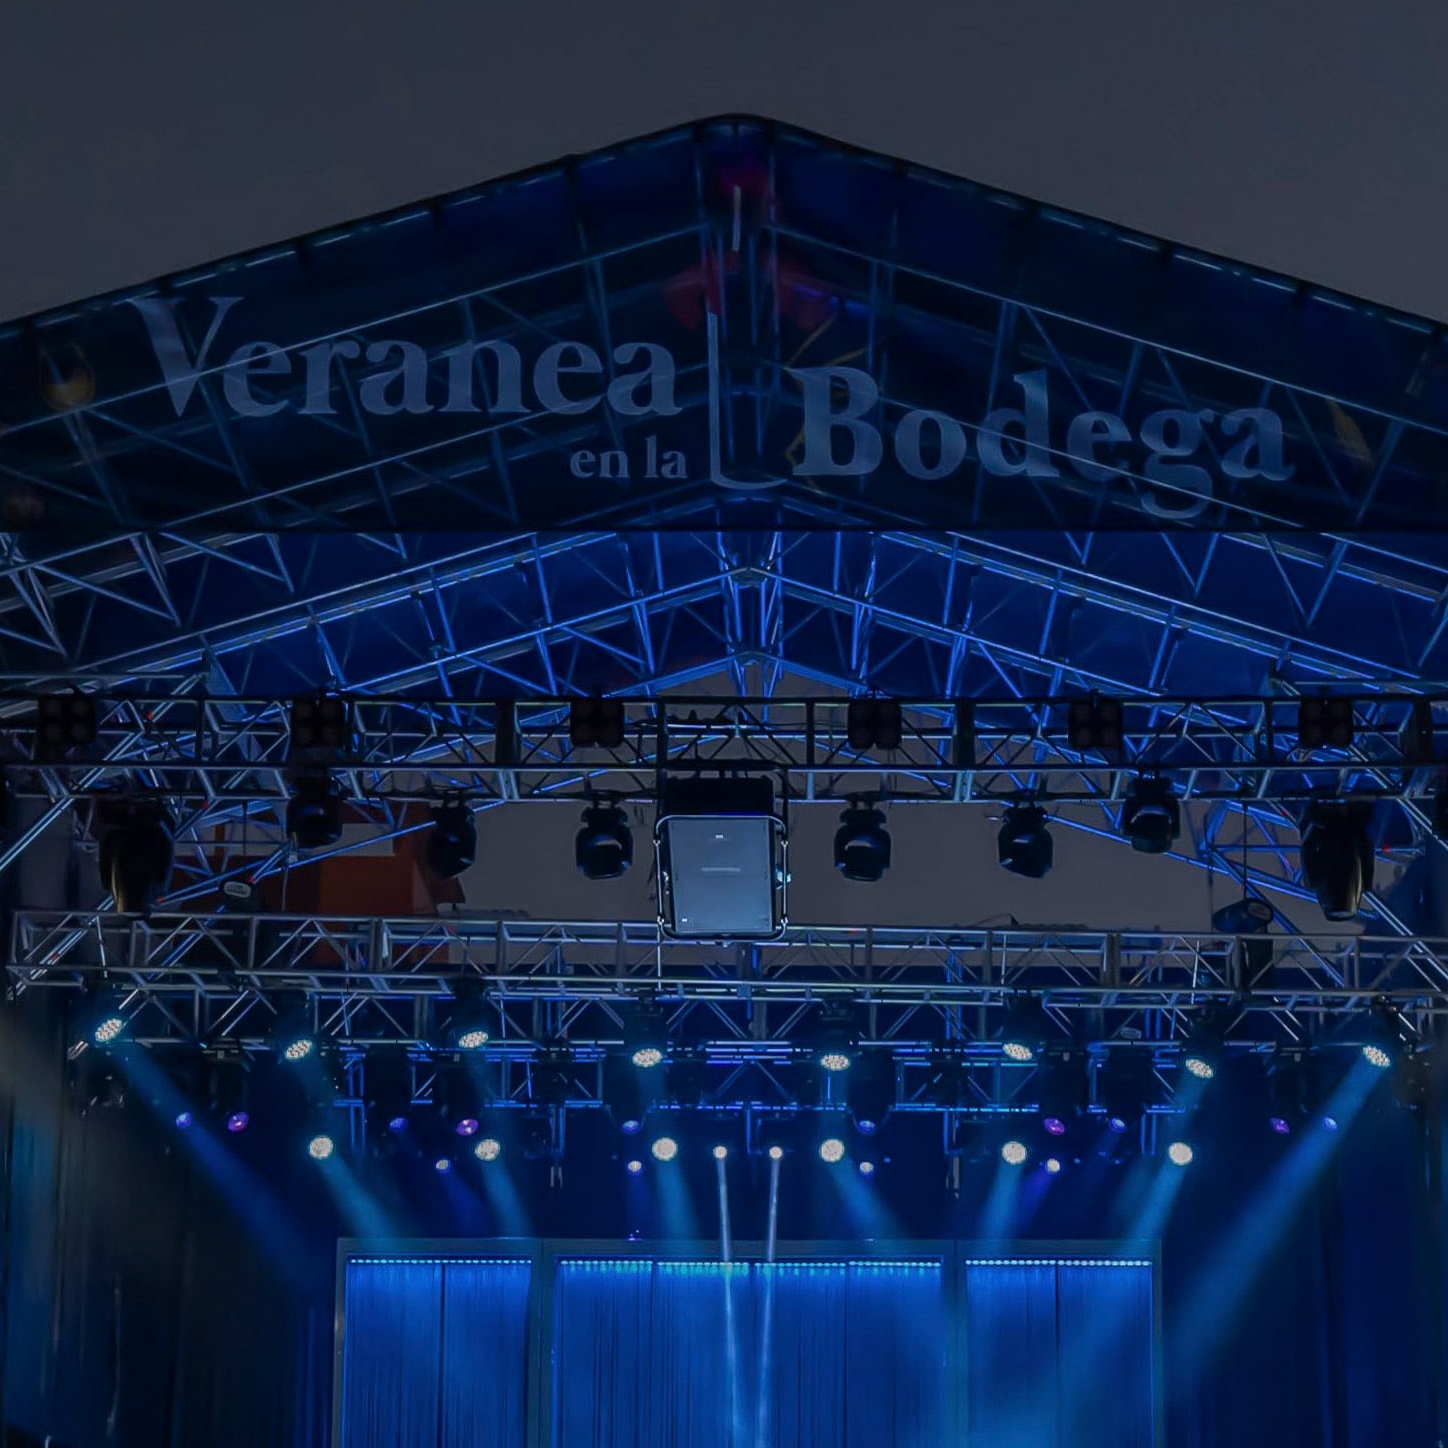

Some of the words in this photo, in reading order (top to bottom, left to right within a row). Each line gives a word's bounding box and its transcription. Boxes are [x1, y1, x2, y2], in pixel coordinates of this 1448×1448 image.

[123, 295, 684, 418] Veranea
[570, 446, 631, 479] en
[643, 434, 689, 480] la
[790, 365, 1297, 520] Bodega
